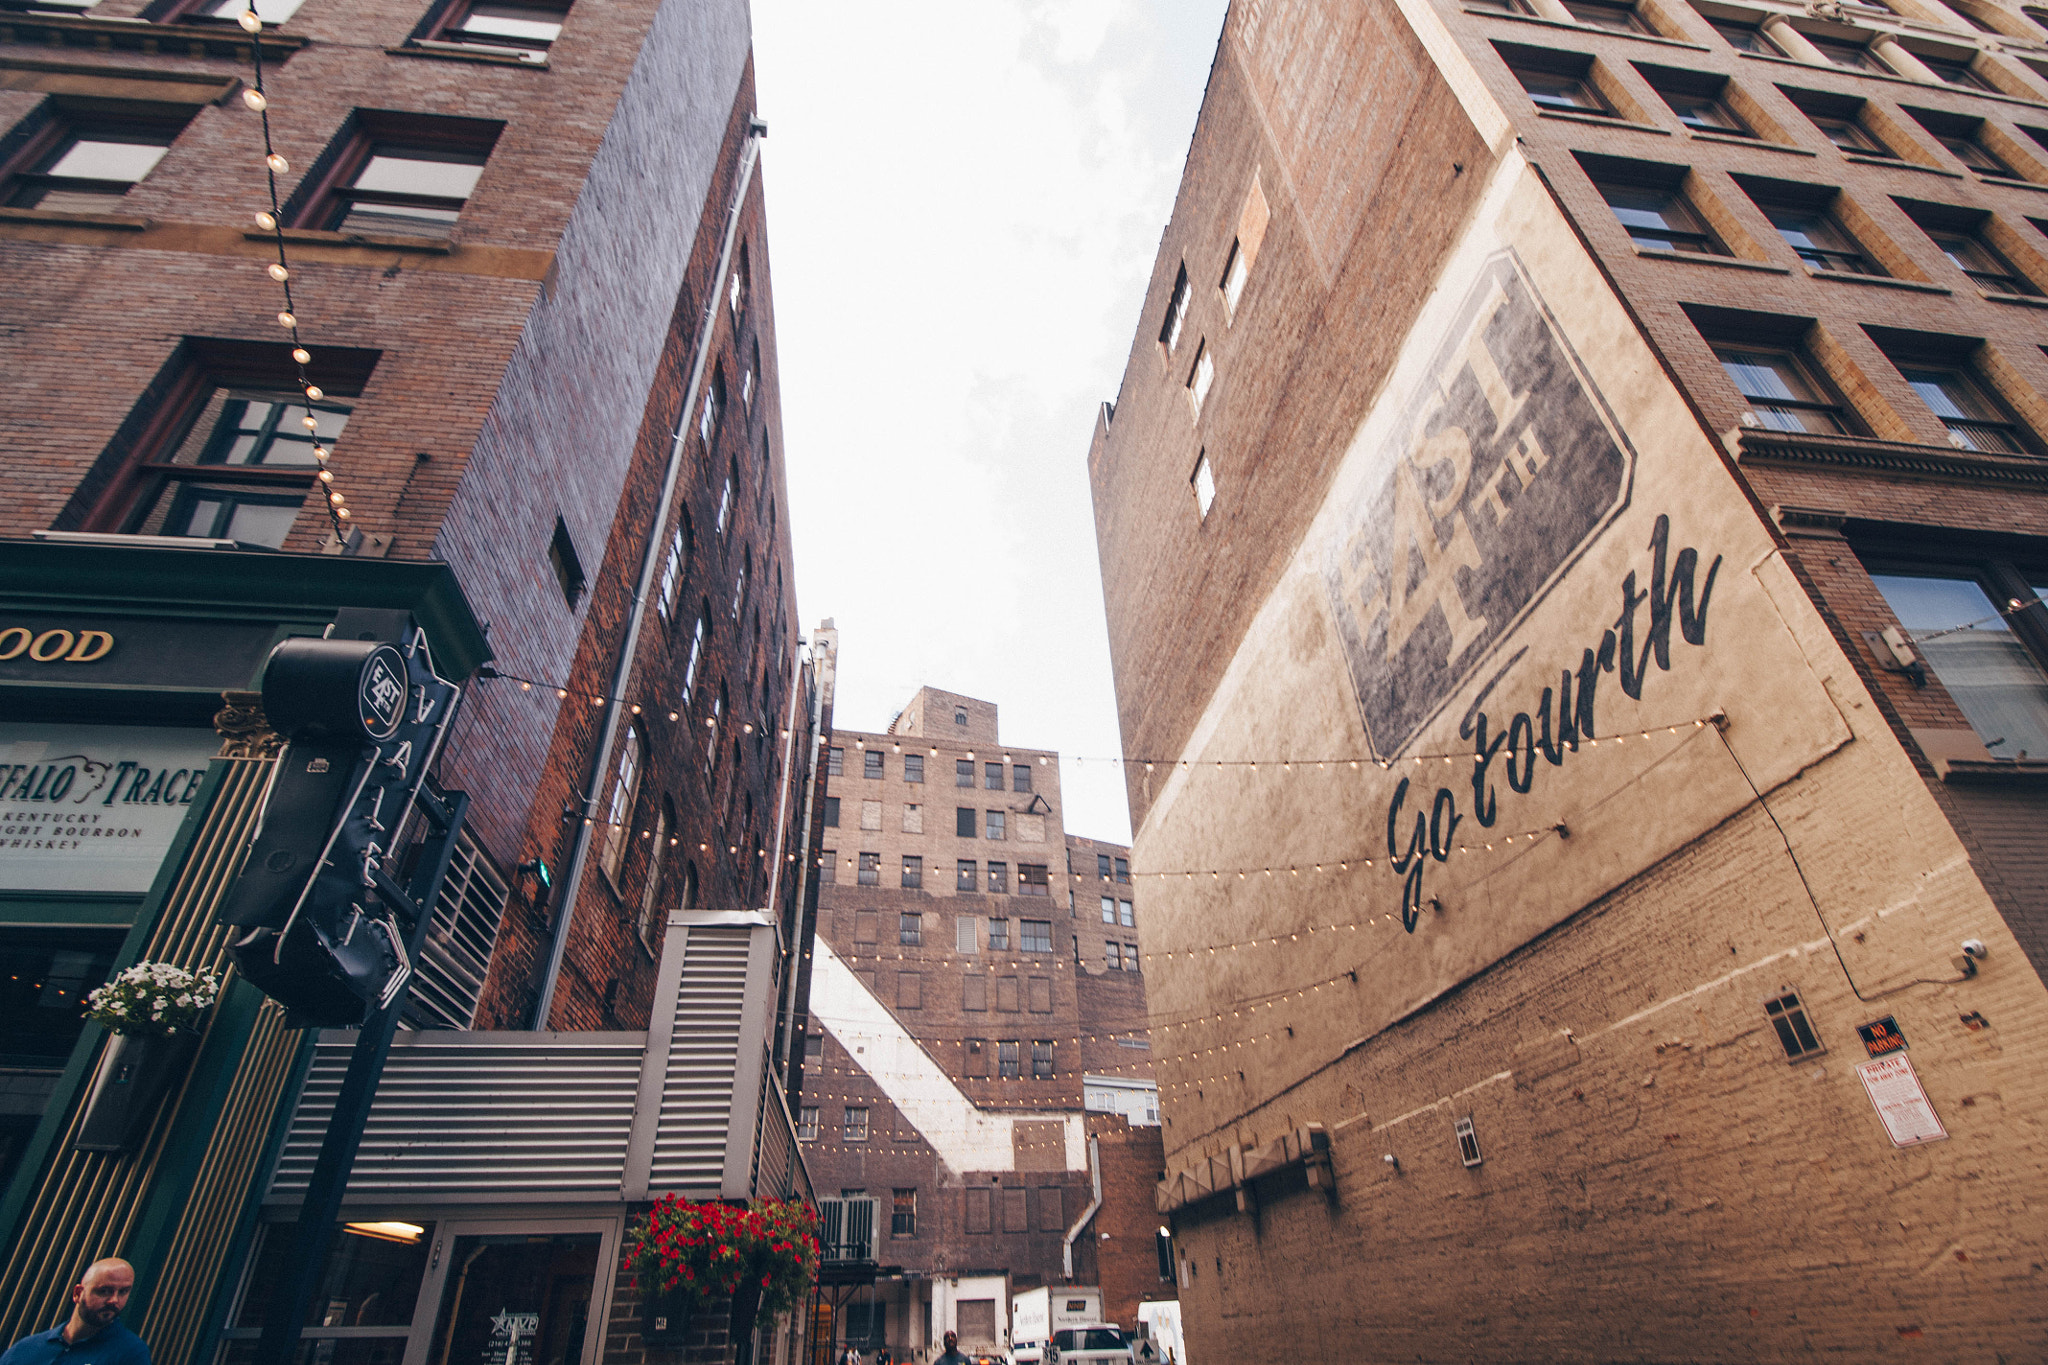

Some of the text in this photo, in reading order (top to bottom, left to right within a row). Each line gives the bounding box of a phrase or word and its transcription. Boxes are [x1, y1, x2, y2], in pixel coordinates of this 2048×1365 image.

[1338, 274, 1530, 662] EAST
[371, 664, 401, 704] EAST
[1387, 513, 1724, 934] Go Fourth
[3, 812, 102, 825] KENTUCKY
[0, 825, 143, 838] GHT BOURBON
[1869, 1022, 1887, 1039] NO
[1866, 1032, 1905, 1056] PARKING
[1866, 1058, 1900, 1074] PRIVATE
[1043, 1346, 1059, 1363] $15
